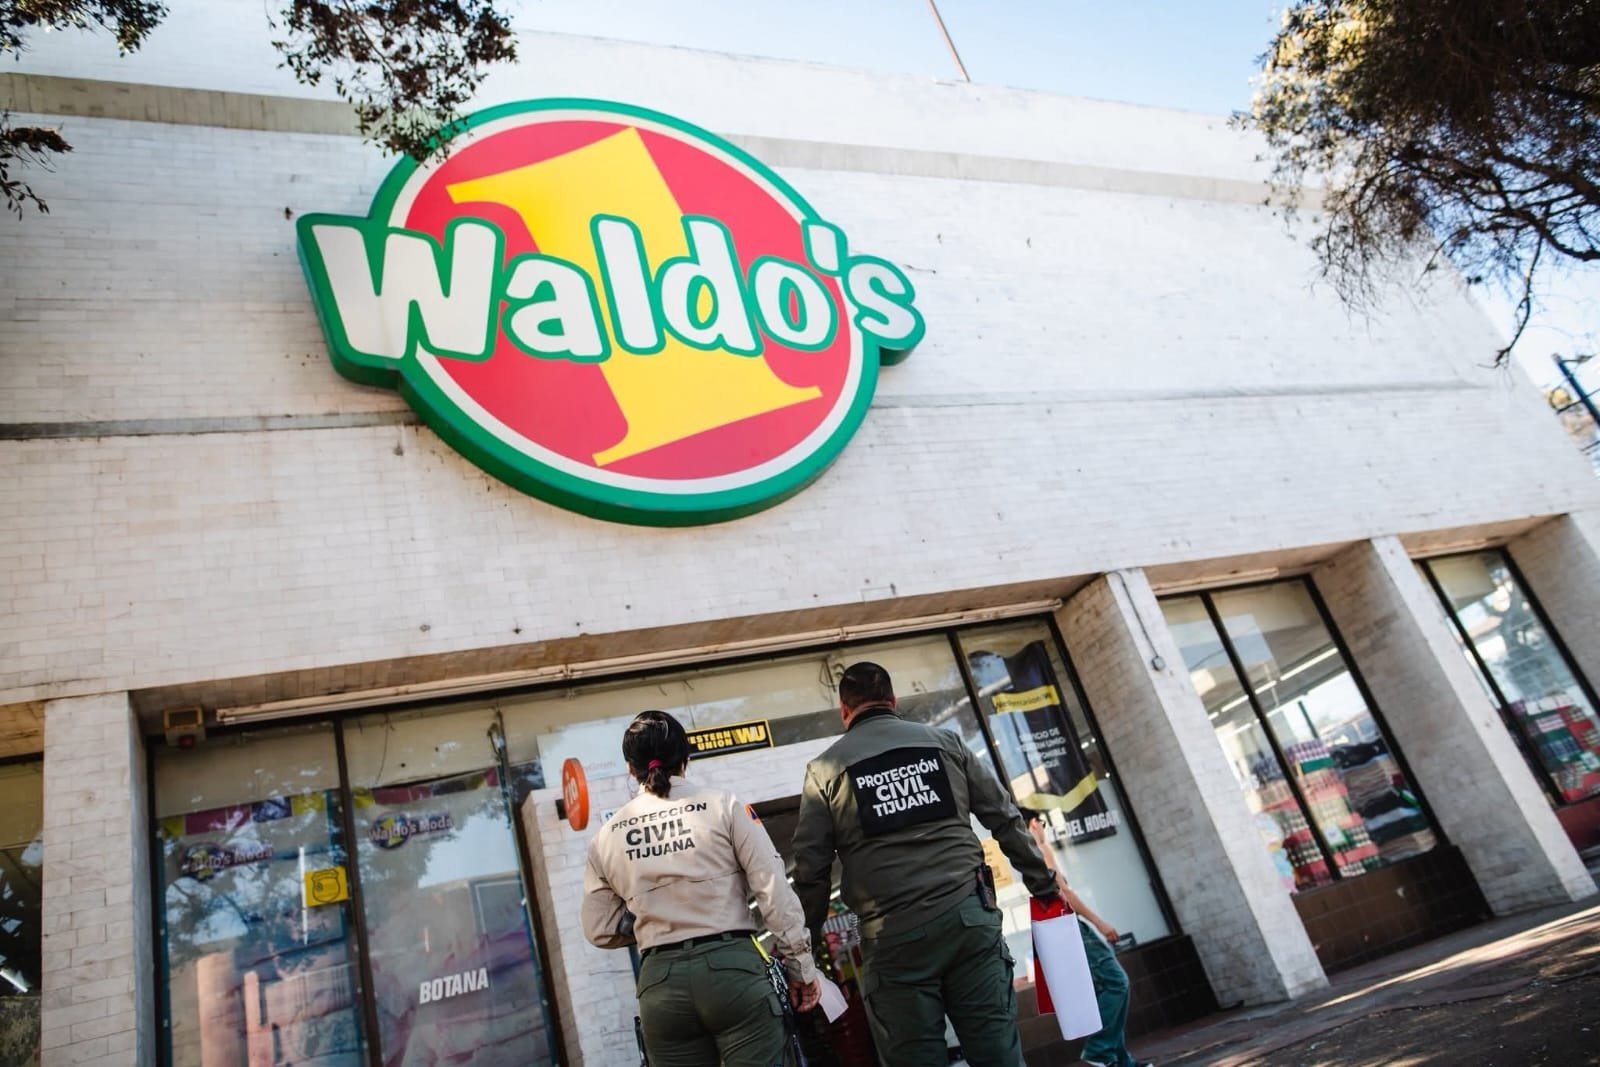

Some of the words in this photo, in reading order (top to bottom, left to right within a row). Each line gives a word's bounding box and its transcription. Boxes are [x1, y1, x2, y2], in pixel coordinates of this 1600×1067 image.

[312, 215, 917, 358] Waldo's
[688, 731, 732, 745] ESTERN
[697, 739, 733, 751] UNION
[733, 725, 767, 744] WU
[856, 759, 940, 789] PROTECCIÓN
[876, 775, 930, 802] CIVIL
[611, 802, 707, 832] PROTECCION
[872, 790, 941, 817] TIJUANA
[626, 819, 692, 846] CIVIL
[1066, 819, 1084, 837] DEL
[1083, 809, 1120, 832] HOGAR
[626, 838, 695, 861] TIJUANA
[419, 967, 489, 1005] BOTANA
